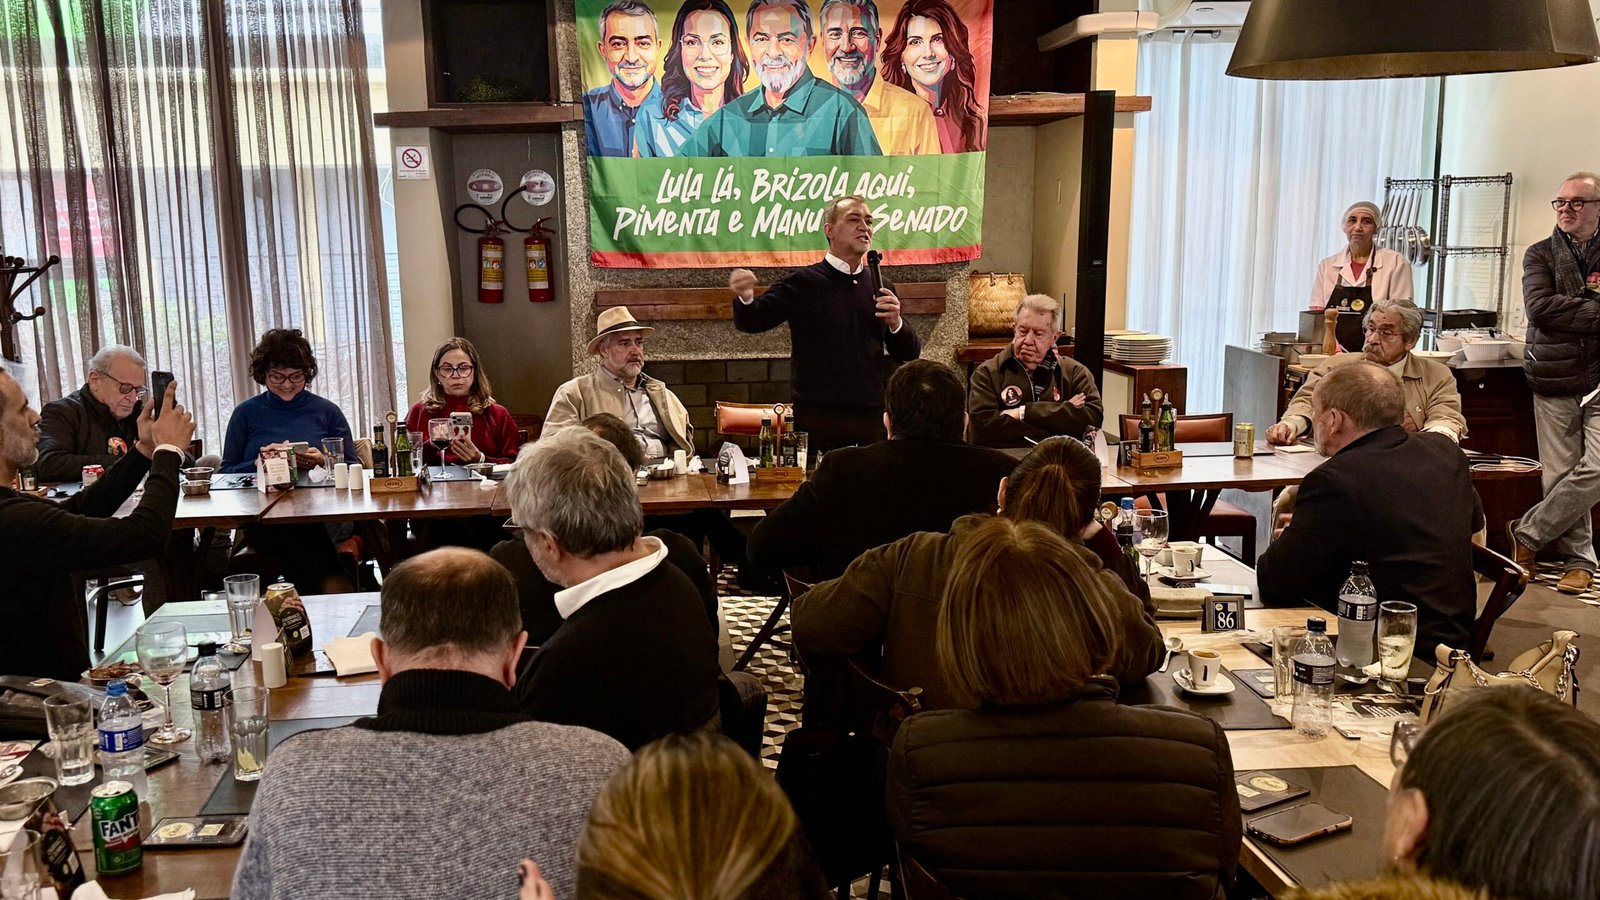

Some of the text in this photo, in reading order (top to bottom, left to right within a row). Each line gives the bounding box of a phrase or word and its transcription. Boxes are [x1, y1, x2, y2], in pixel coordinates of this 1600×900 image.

[656, 167, 703, 204] LULA
[711, 165, 741, 204] LÁ,
[751, 202, 824, 240] MANU
[1217, 611, 1235, 629] 86
[100, 809, 141, 838] FANT
